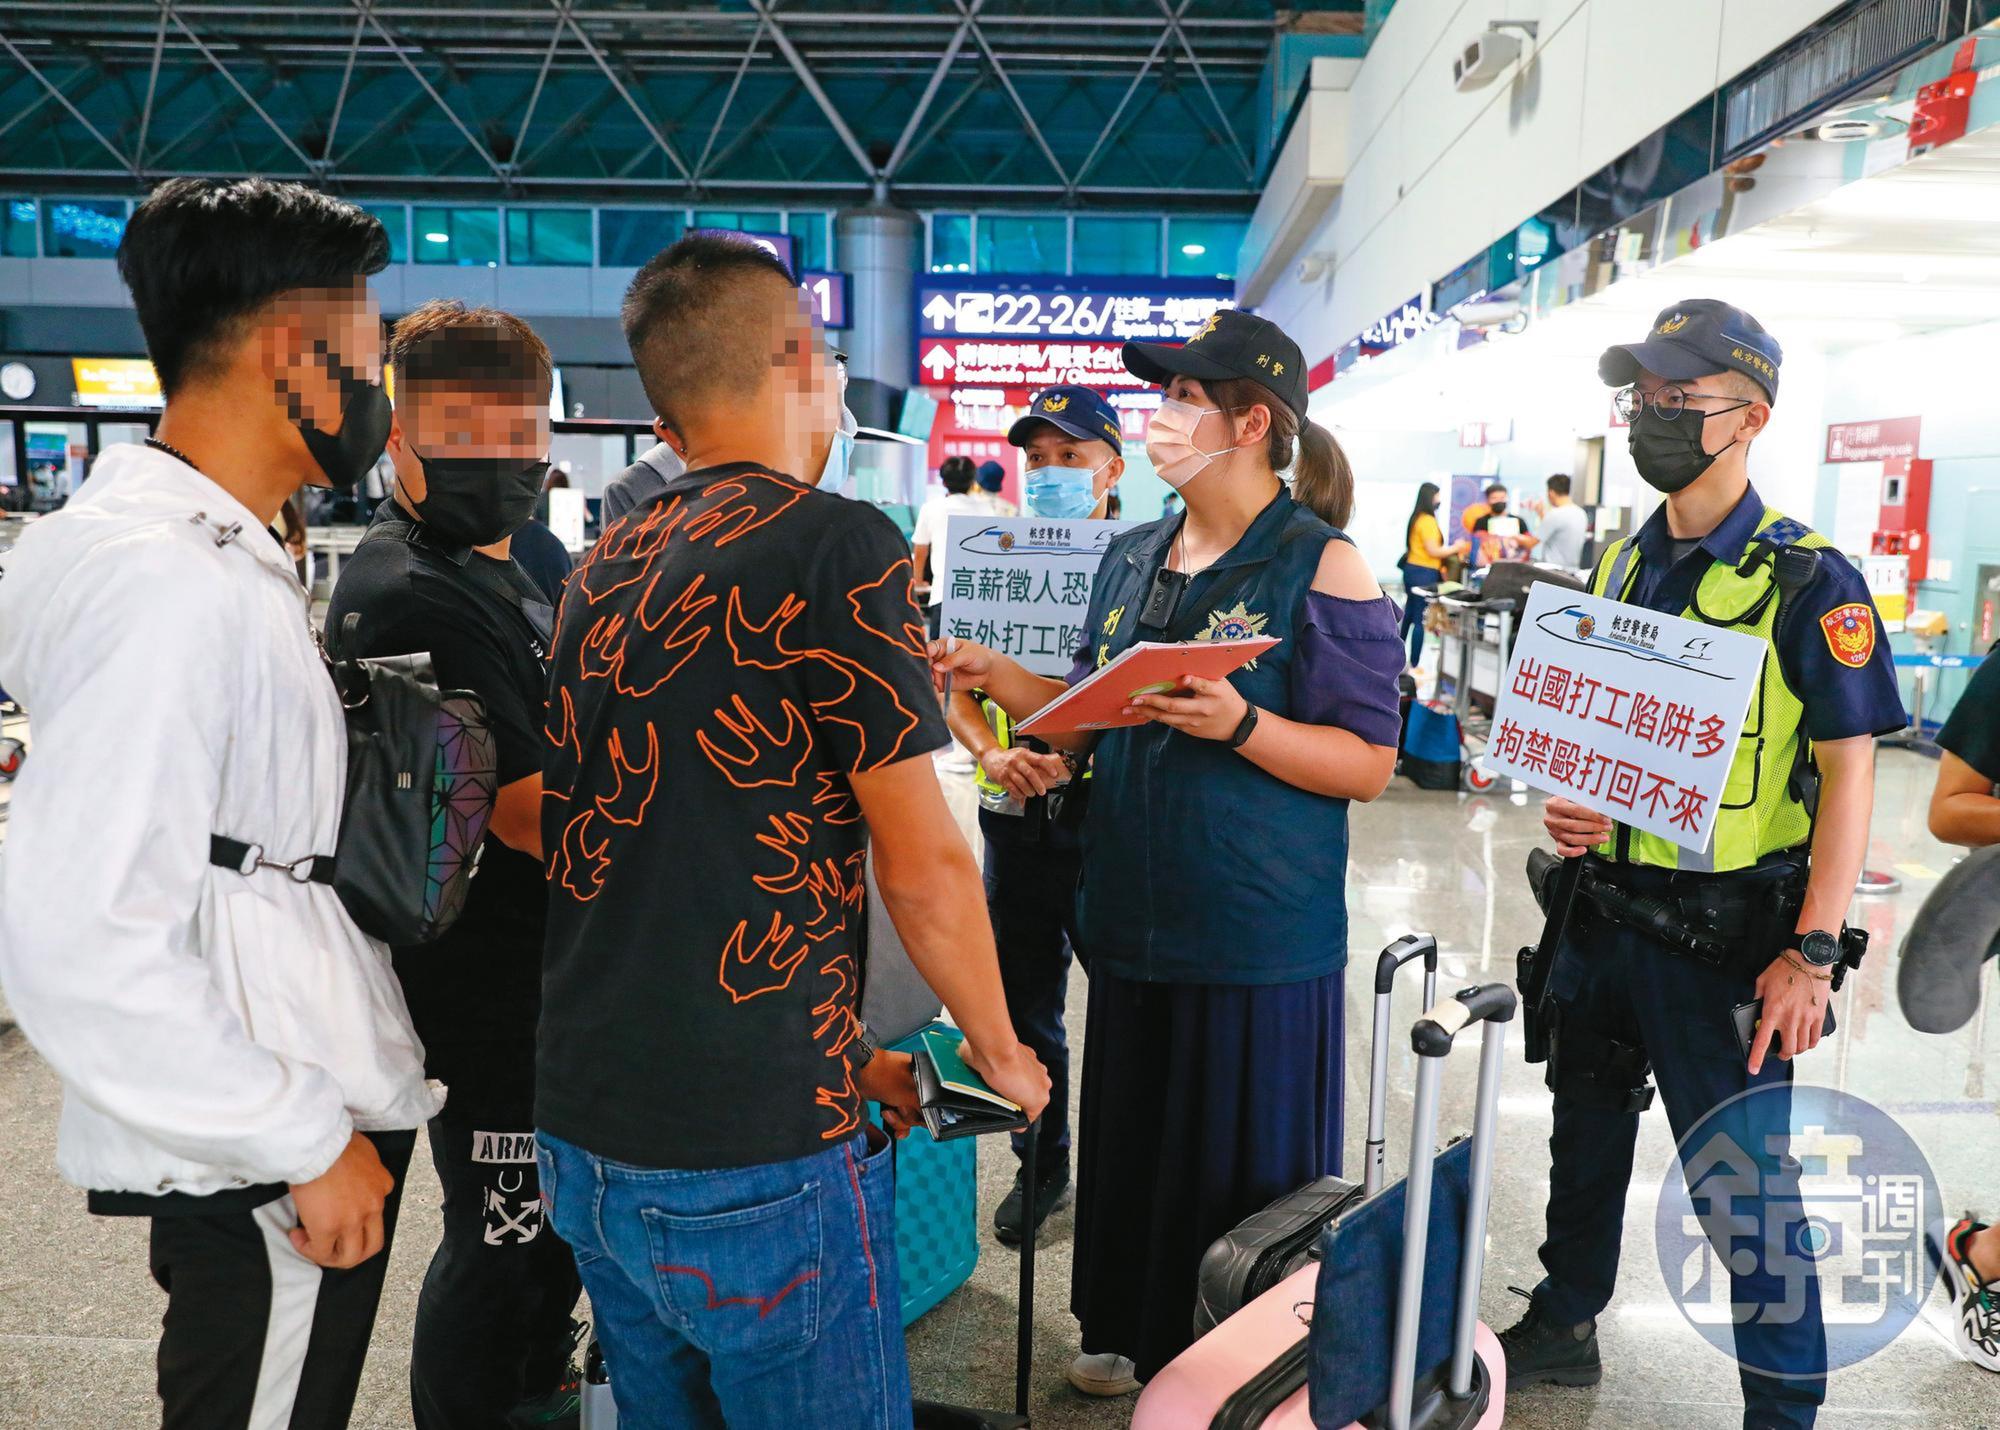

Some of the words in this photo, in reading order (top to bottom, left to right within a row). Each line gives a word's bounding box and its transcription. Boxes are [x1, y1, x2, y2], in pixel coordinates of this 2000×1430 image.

[1256, 354, 1285, 376] 刑警
[1029, 526, 1071, 541] 航空警察局
[951, 566, 1098, 605] 高薪徵人恐
[1612, 614, 1659, 641] 航空警察局
[1511, 656, 1726, 759] 出國打工陷阱多
[1493, 717, 1709, 834] 拘禁毆打回不來
